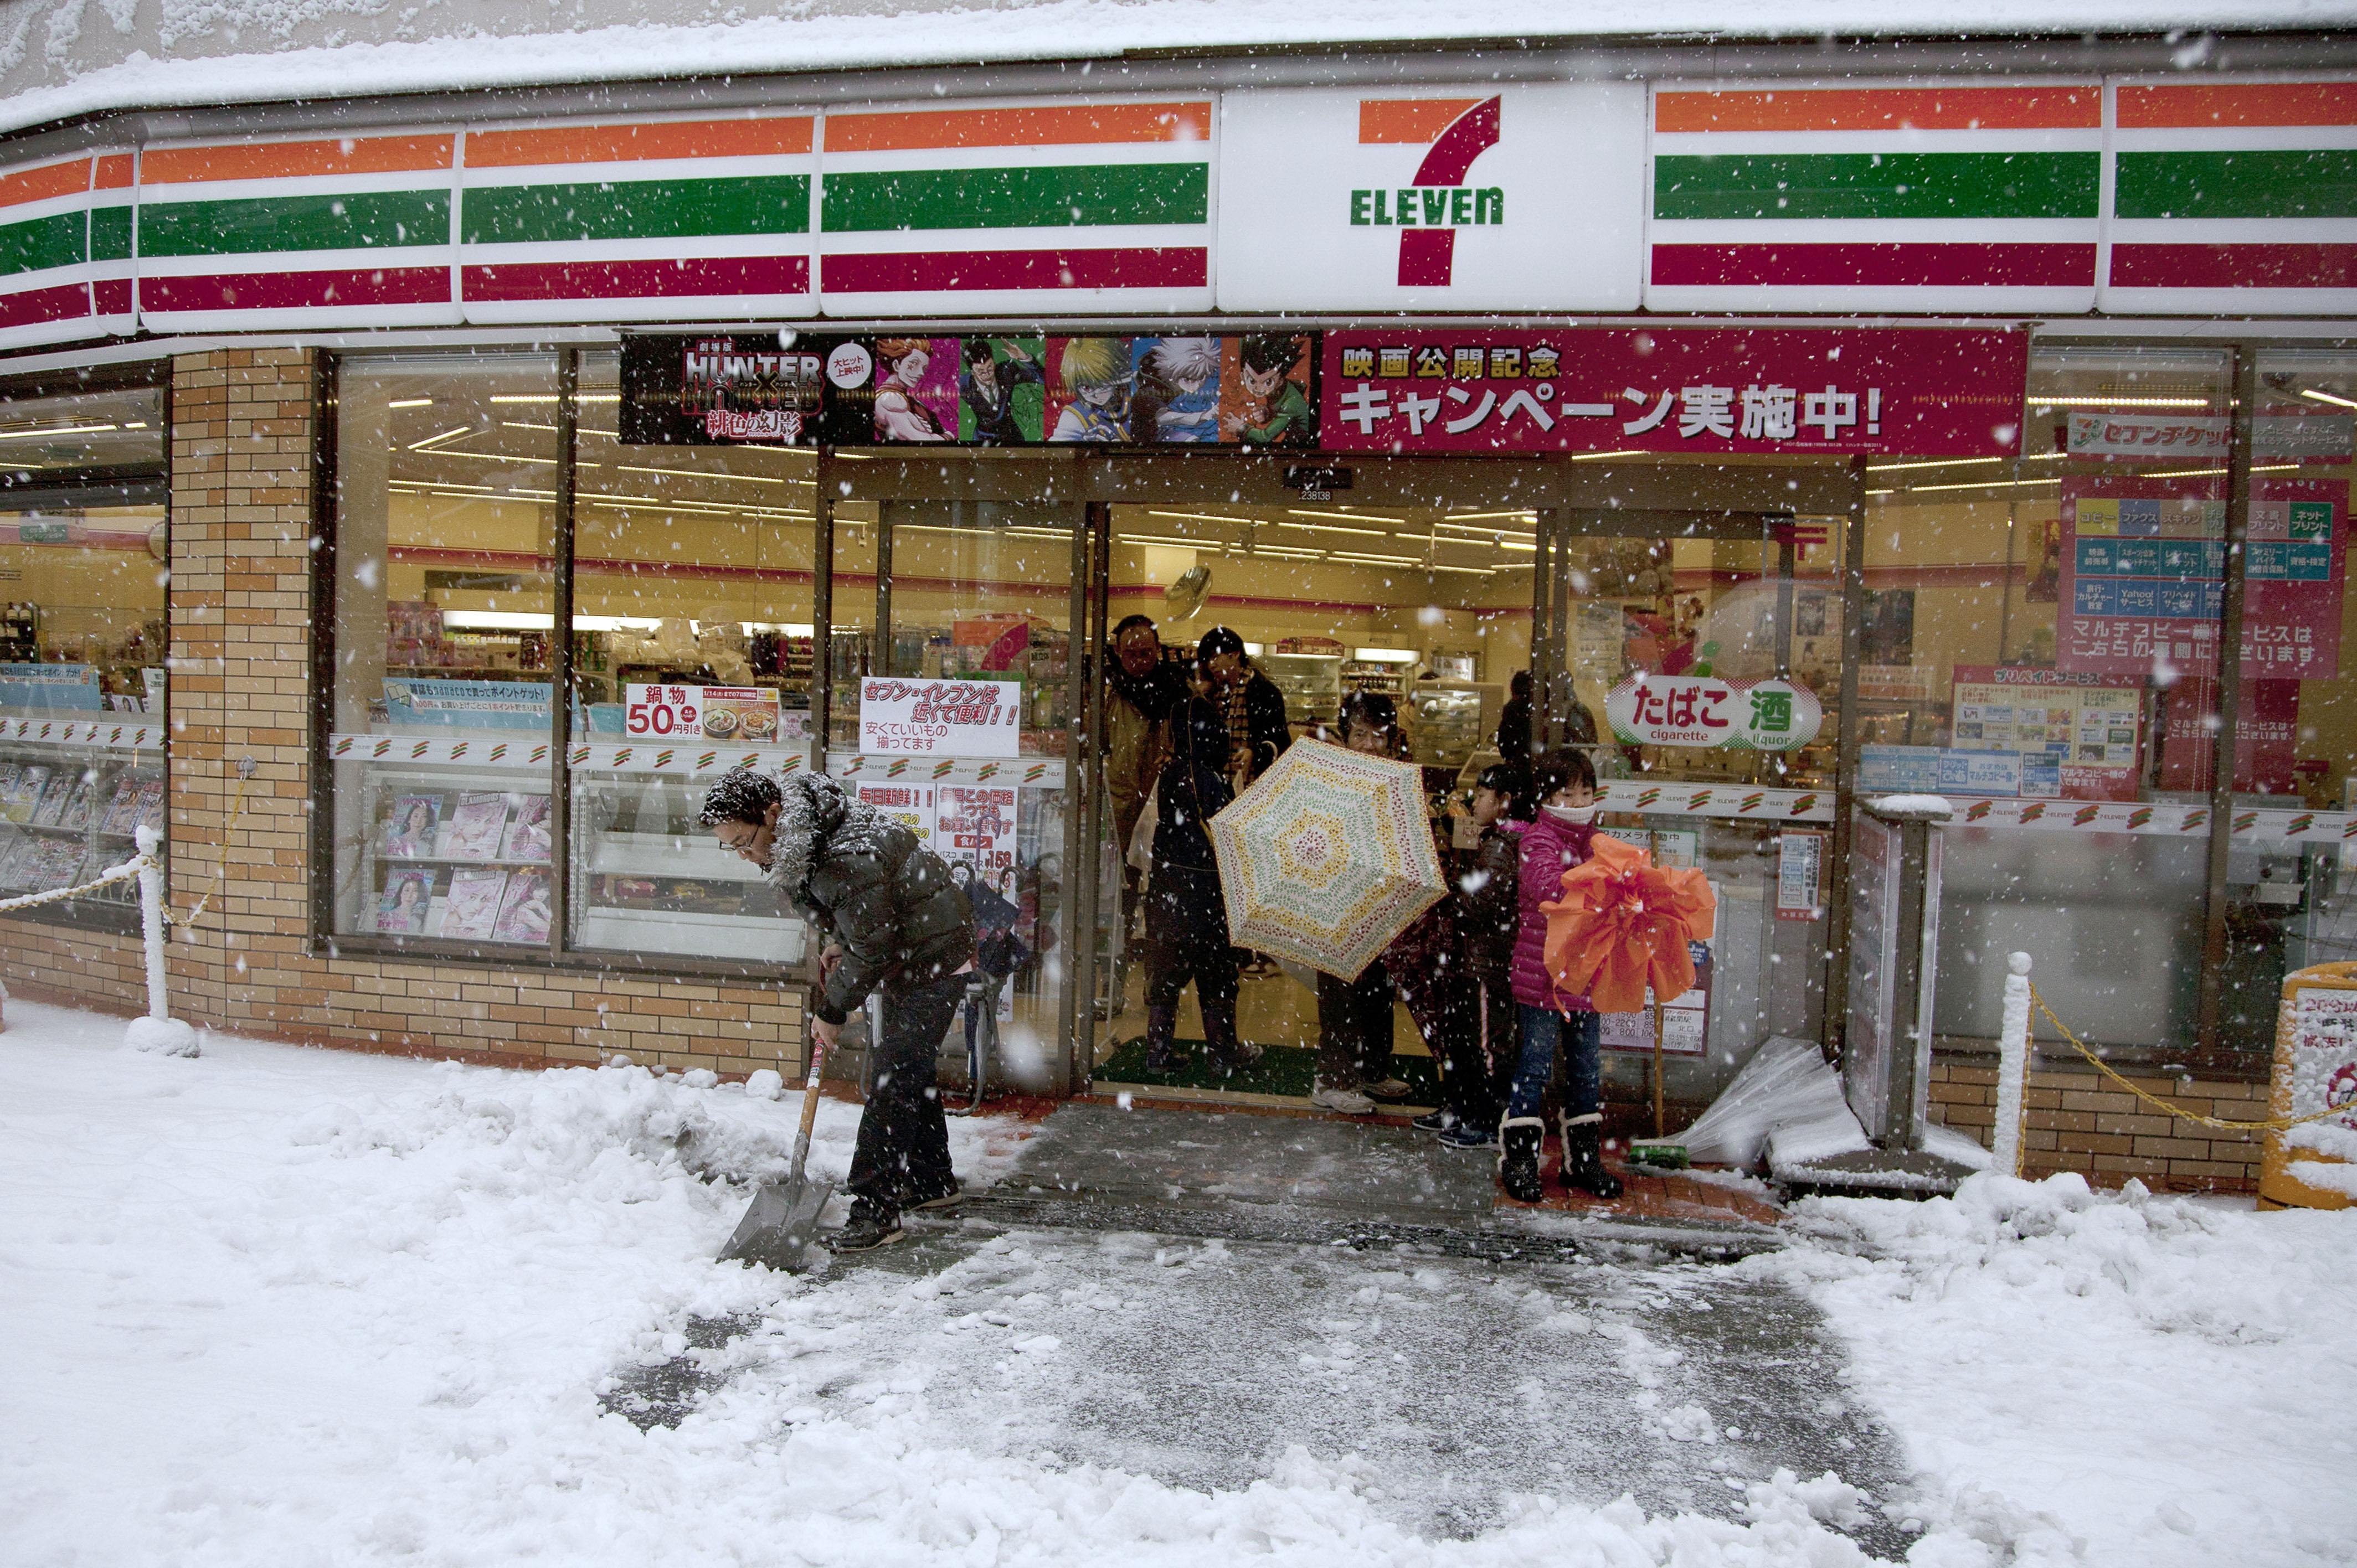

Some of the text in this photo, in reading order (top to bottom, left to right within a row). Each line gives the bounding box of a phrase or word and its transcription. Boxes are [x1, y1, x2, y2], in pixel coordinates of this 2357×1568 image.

[1359, 94, 1501, 286] 7
[699, 342, 733, 352] 劇場版
[686, 352, 821, 383] HUNTER
[833, 355, 863, 368] 大ヒット
[1342, 347, 1561, 378] 映画公開記念
[1340, 382, 1881, 440] キャンペーン実施中!
[708, 410, 801, 437] 緋色の幻影
[1301, 491, 1331, 500] 238138
[2081, 513, 2115, 523] コピー
[2122, 513, 2158, 523] ファクス
[2163, 514, 2201, 524] スキャン
[2297, 510, 2325, 520] ネット
[2292, 521, 2329, 532] プリント
[2121, 590, 2154, 599] Yahoo!
[2121, 598, 2154, 607] サービス
[864, 681, 1000, 704] セブン・イレブンは
[1633, 684, 1793, 732] たばこ 酒
[866, 721, 948, 737] 安くていいもの
[1650, 729, 1709, 741] cigarette
[877, 735, 936, 750] 揃ってます
[940, 787, 1015, 806] 毎日この価格
[959, 836, 988, 847] 食パン
